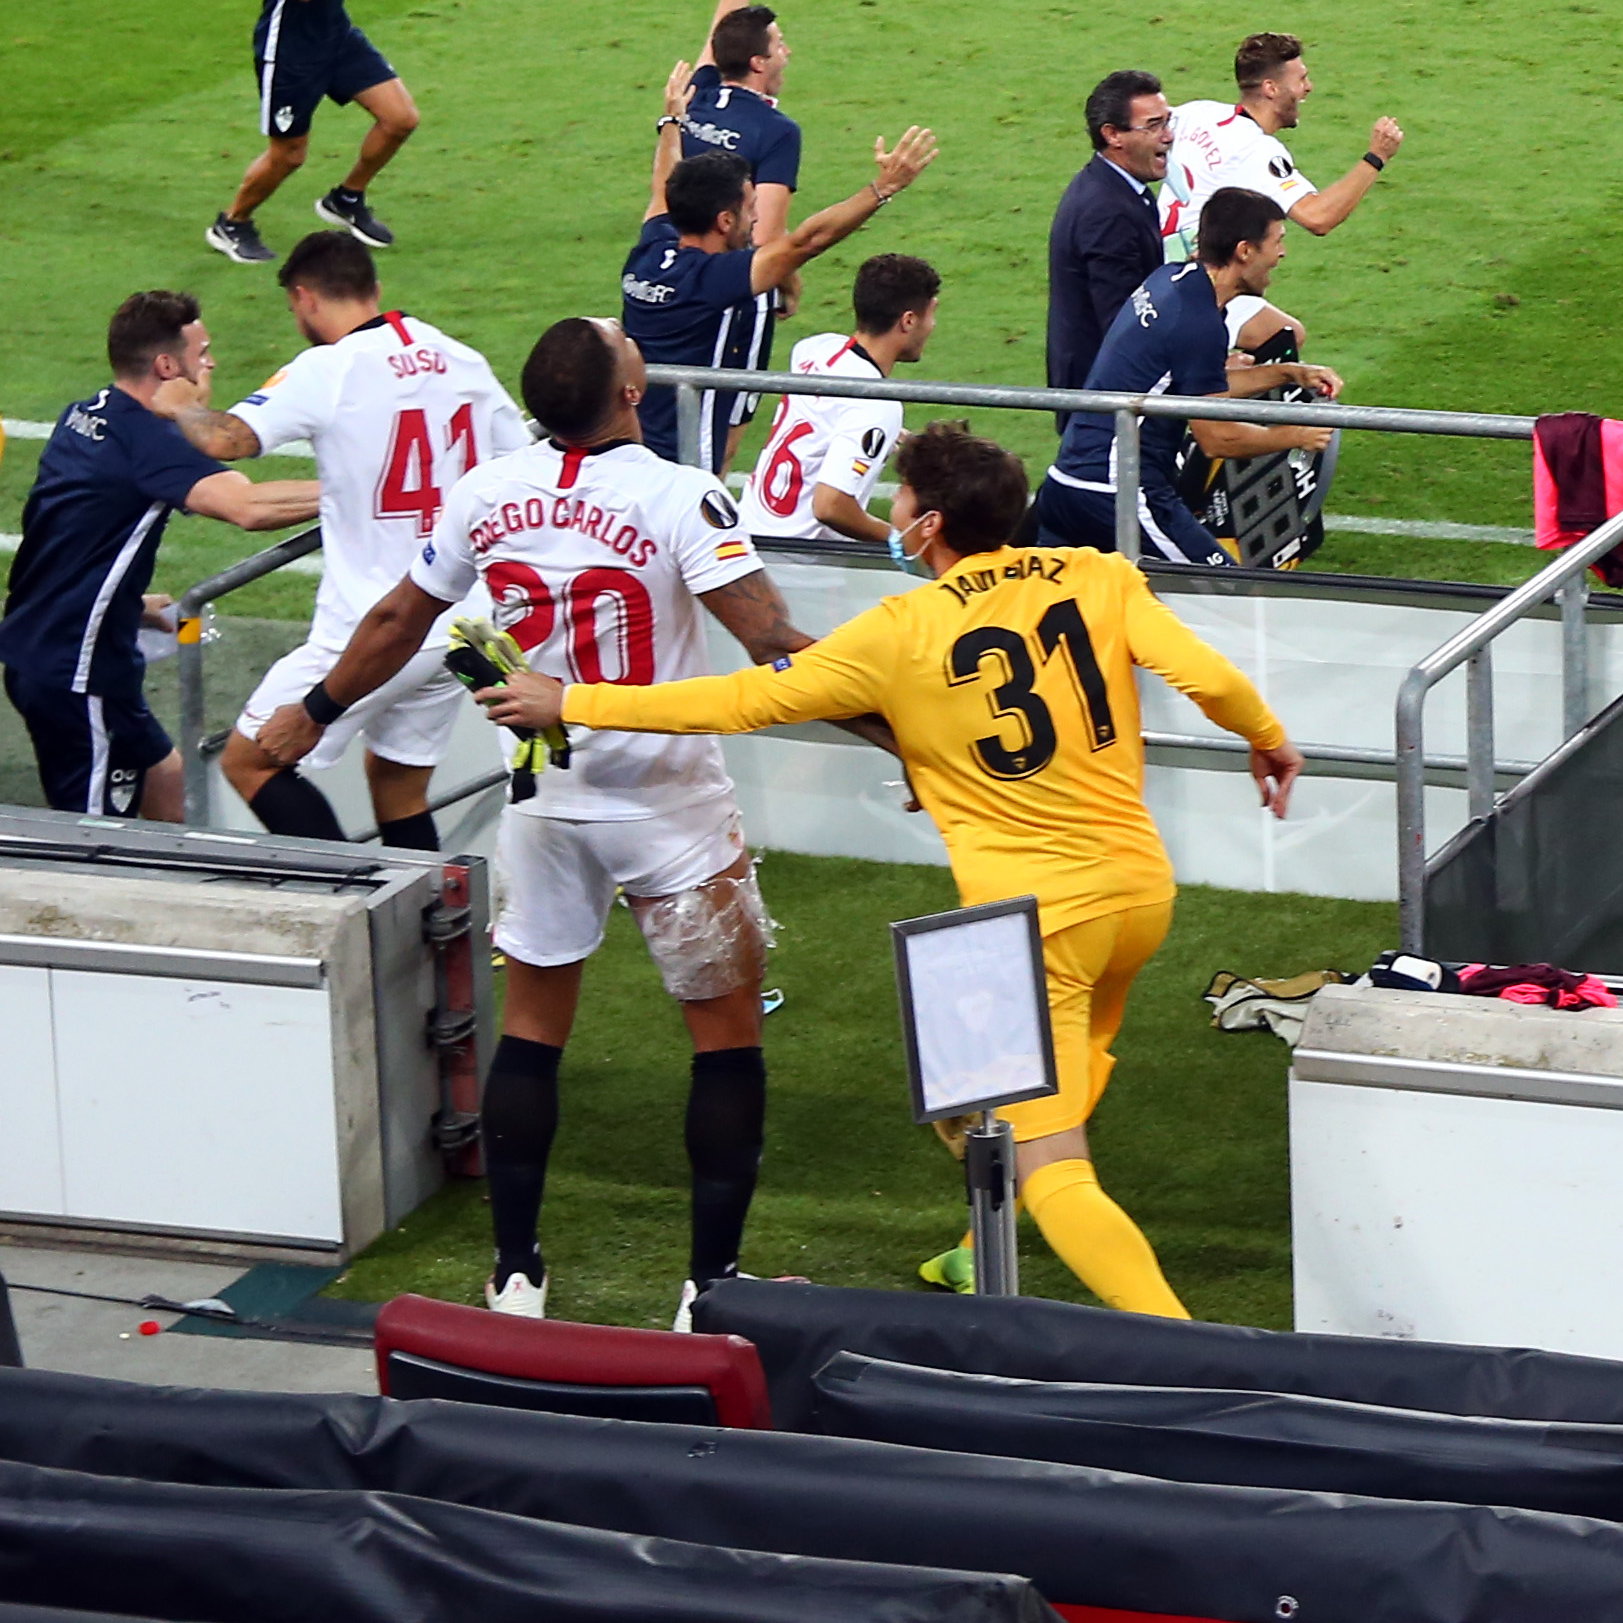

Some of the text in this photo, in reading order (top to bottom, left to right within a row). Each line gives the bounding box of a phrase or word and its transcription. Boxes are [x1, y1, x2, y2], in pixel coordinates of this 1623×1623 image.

[387, 346, 448, 378] SUSO
[373, 401, 481, 539] 41
[468, 497, 659, 568] DIEGO CARLOS
[478, 561, 655, 686] 20
[942, 597, 1119, 782] 31
